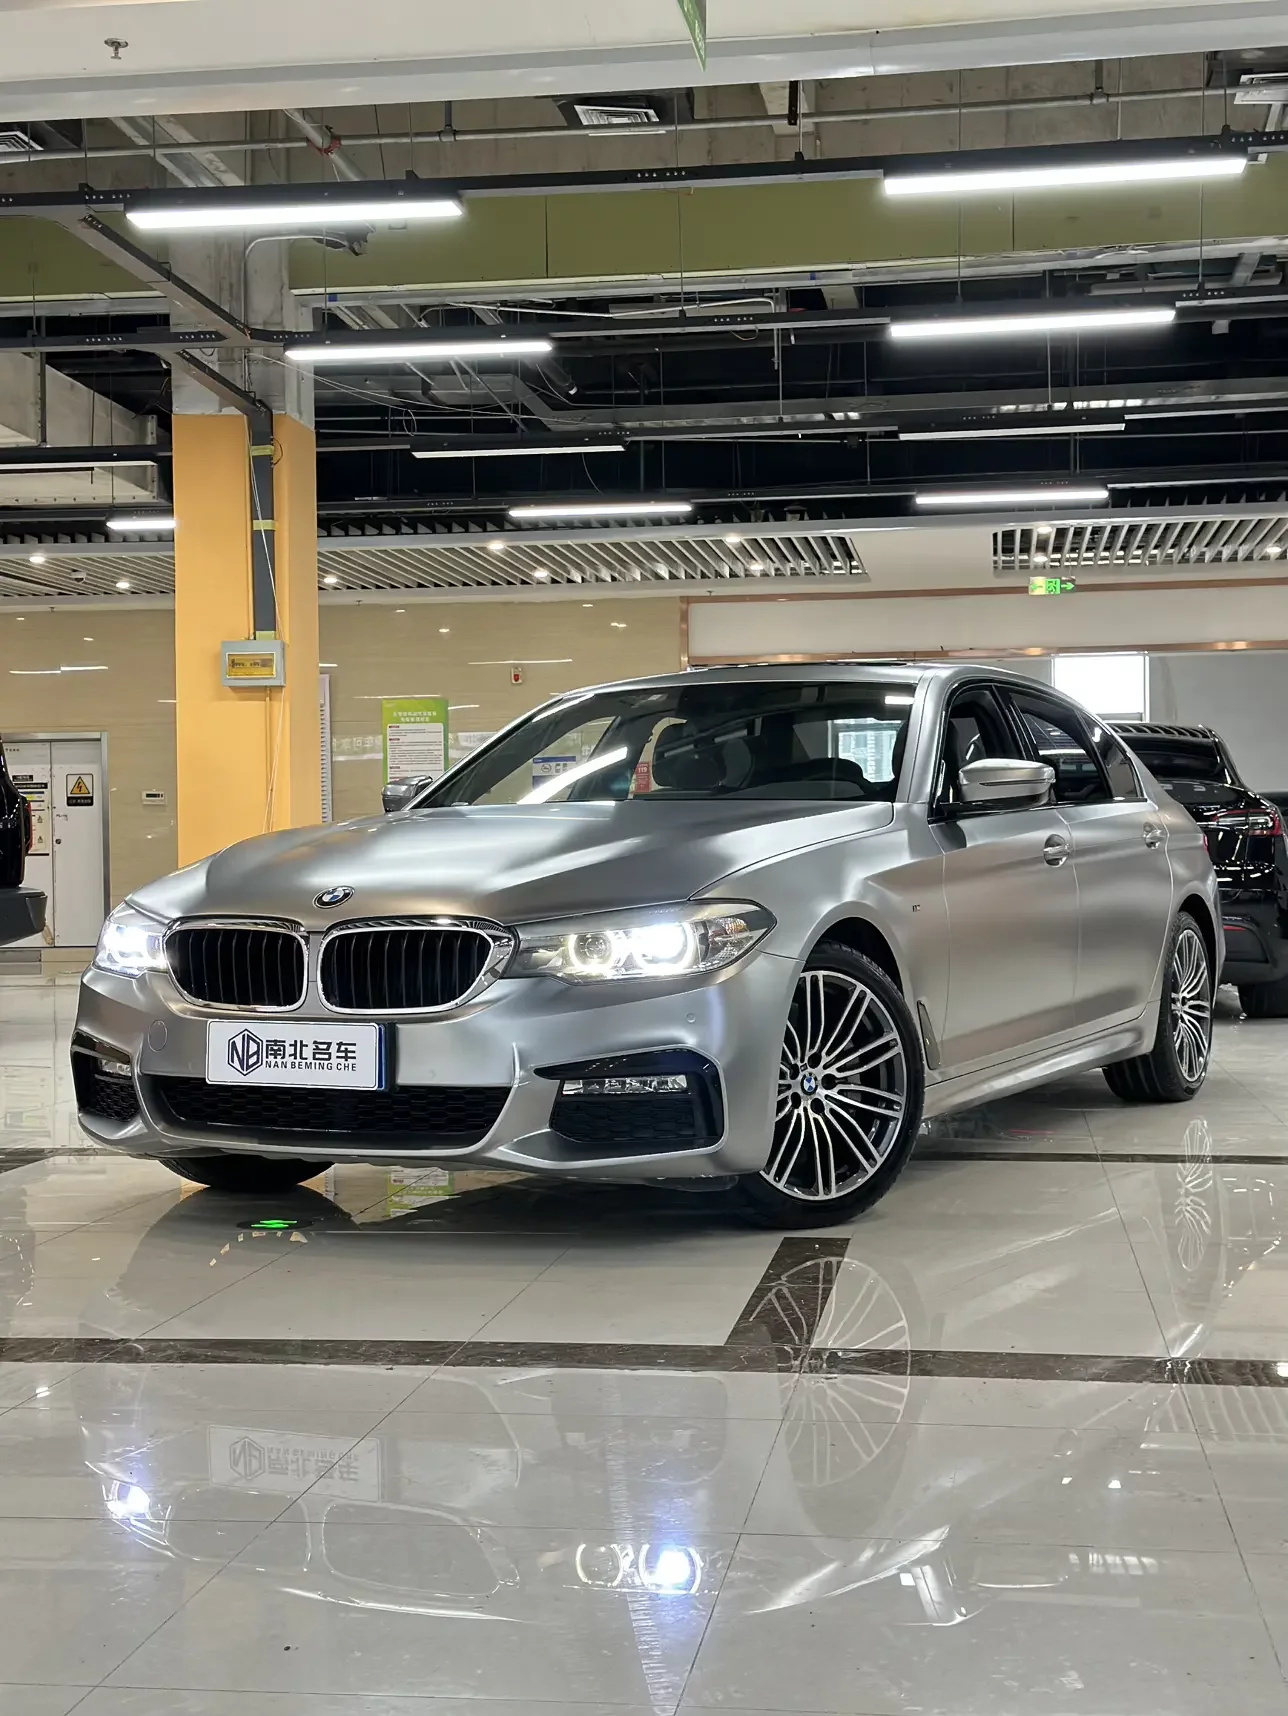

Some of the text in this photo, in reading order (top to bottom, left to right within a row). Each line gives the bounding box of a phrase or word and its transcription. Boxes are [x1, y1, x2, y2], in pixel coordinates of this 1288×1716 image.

[265, 1039, 357, 1062] 南北名车
[265, 1061, 357, 1072] NAN BEMING CHE
